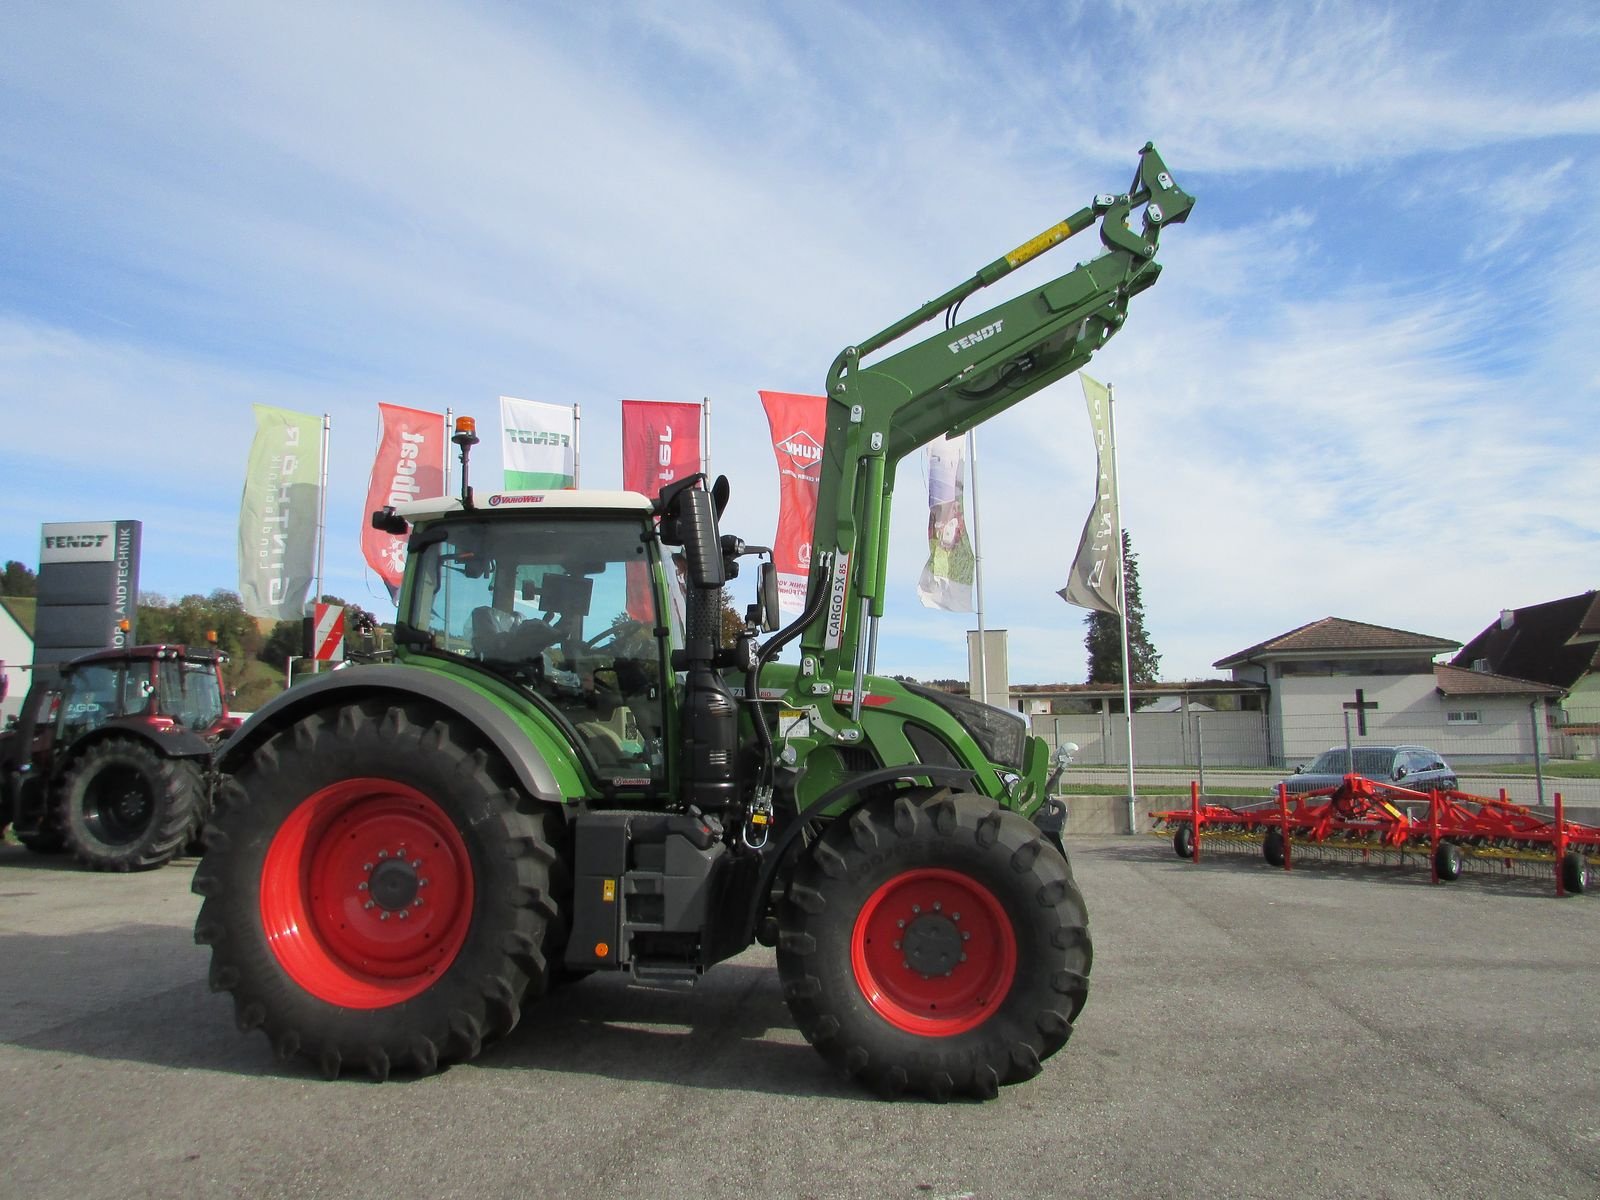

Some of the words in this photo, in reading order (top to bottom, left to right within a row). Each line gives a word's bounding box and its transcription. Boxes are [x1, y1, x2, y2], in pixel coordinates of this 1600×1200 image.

[947, 319, 1004, 355] FENDT
[45, 534, 109, 549] FENDT
[839, 563, 847, 575] 85
[834, 575, 845, 594] 5X
[829, 596, 844, 637] CARGO
